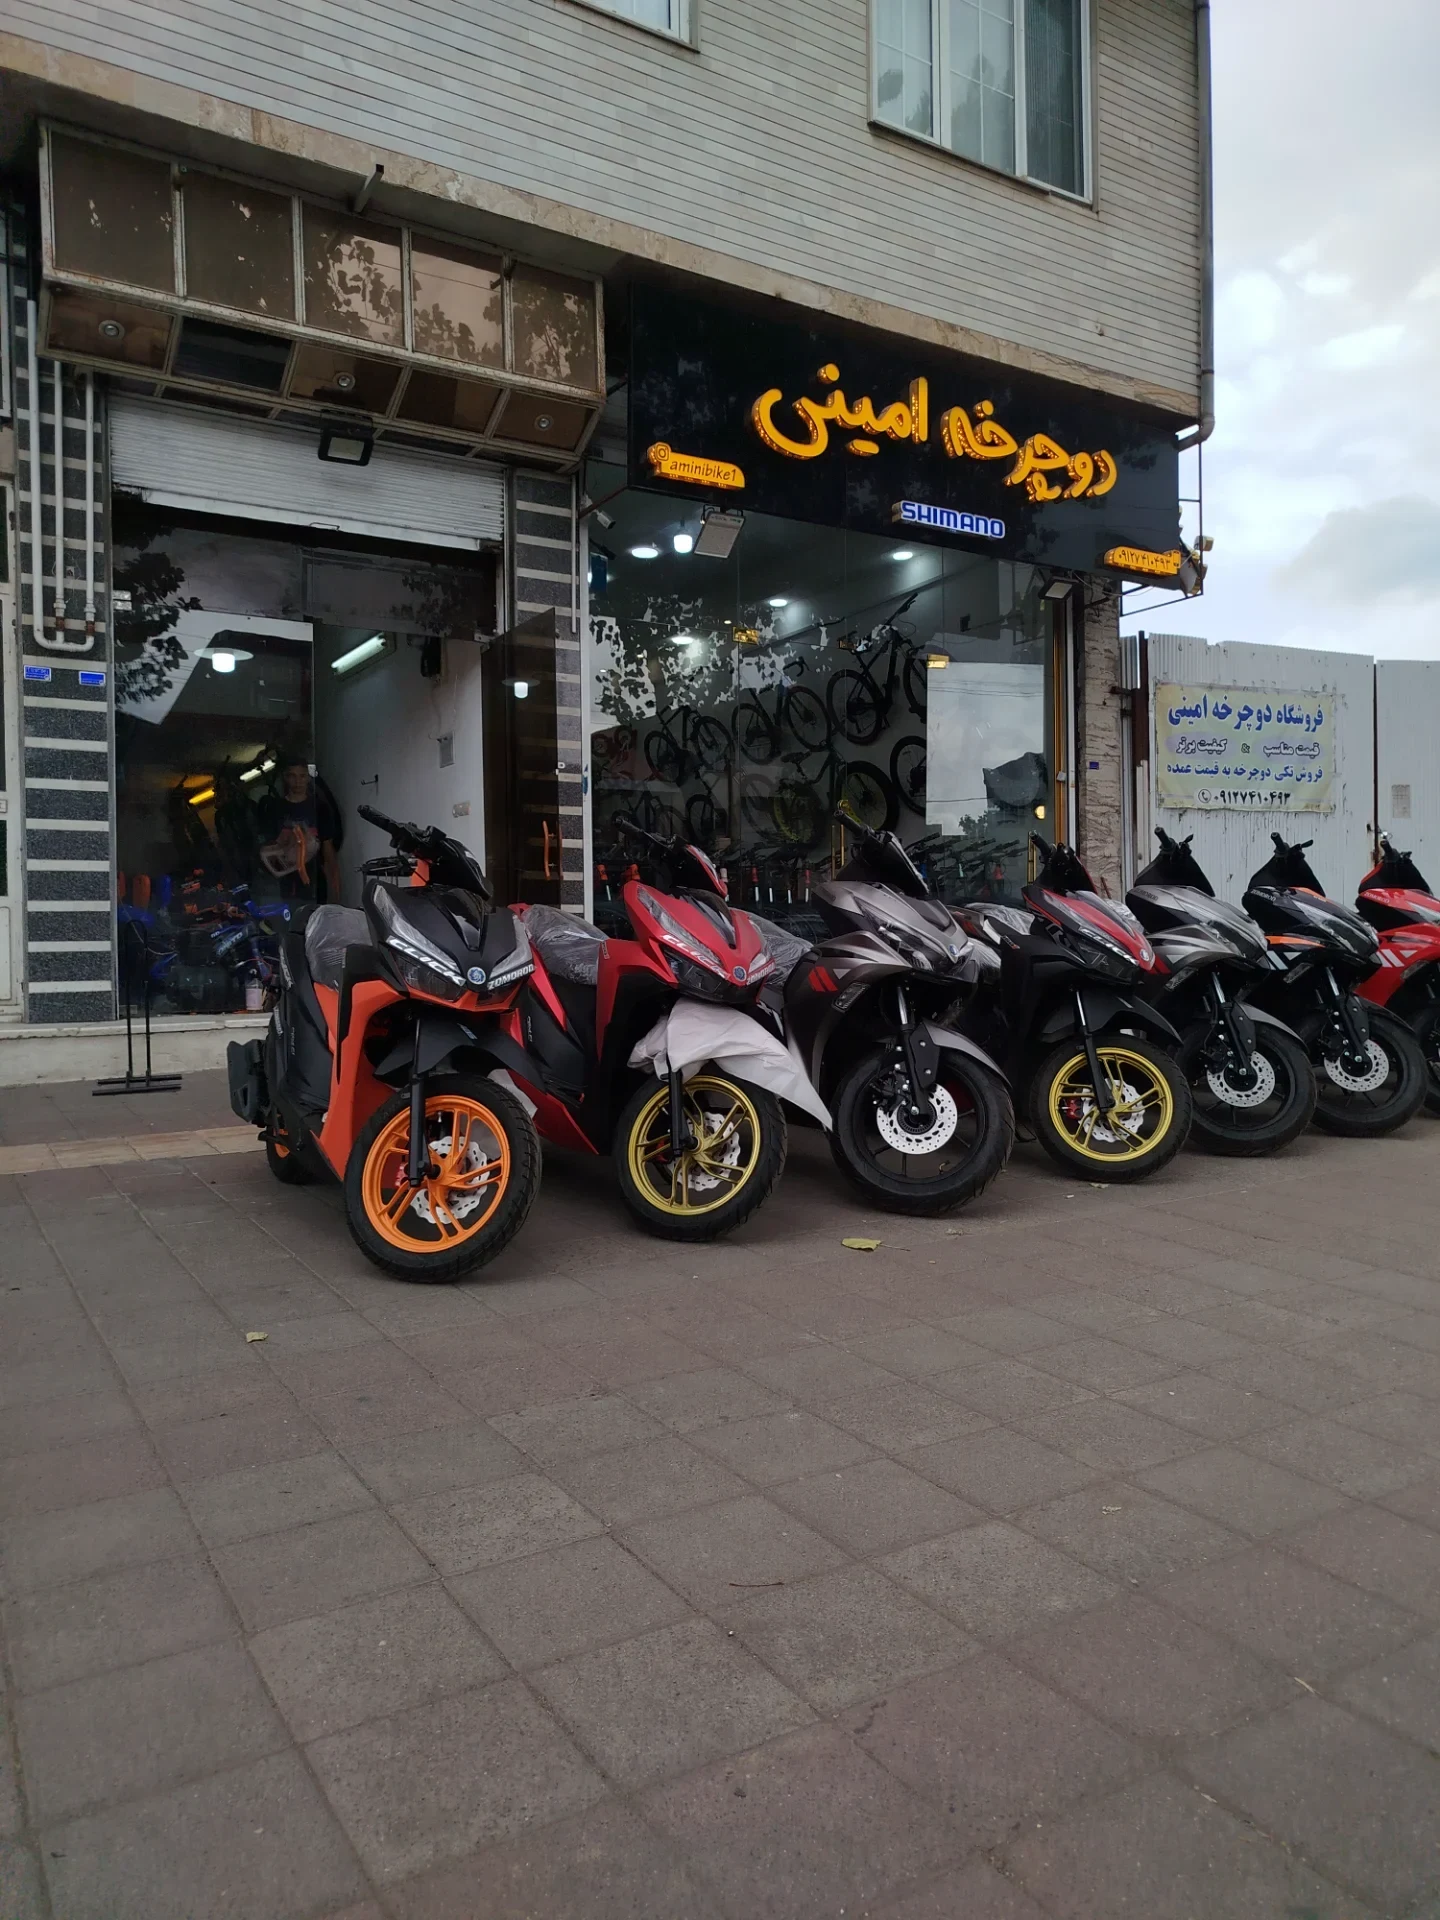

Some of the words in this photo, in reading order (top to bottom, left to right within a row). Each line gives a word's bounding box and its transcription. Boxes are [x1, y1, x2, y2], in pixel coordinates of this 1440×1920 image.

[752, 363, 928, 459] امینی
[941, 399, 1118, 501] دوچرخه
[669, 461, 737, 482] aminibike1
[901, 501, 1005, 538] SHIMANO
[1168, 692, 1208, 726] امینی
[1213, 694, 1272, 731] دوچرخه
[1276, 703, 1324, 732] فروشگاه
[1175, 736, 1197, 755] برتر
[1197, 738, 1228, 755] کیفیت
[1263, 741, 1295, 758] مناسب
[1295, 742, 1320, 760] قیمت
[1167, 763, 1192, 774] عمده
[1194, 761, 1219, 778] قیمت
[1222, 765, 1231, 779] به
[1274, 765, 1294, 781] تکی
[1295, 765, 1323, 783] فروش
[1214, 789, 1291, 806] ۰۹۱۲۷۴۱۰۴۹۳
[387, 938, 466, 987] CLICK
[486, 963, 535, 991] ZOMOROD
